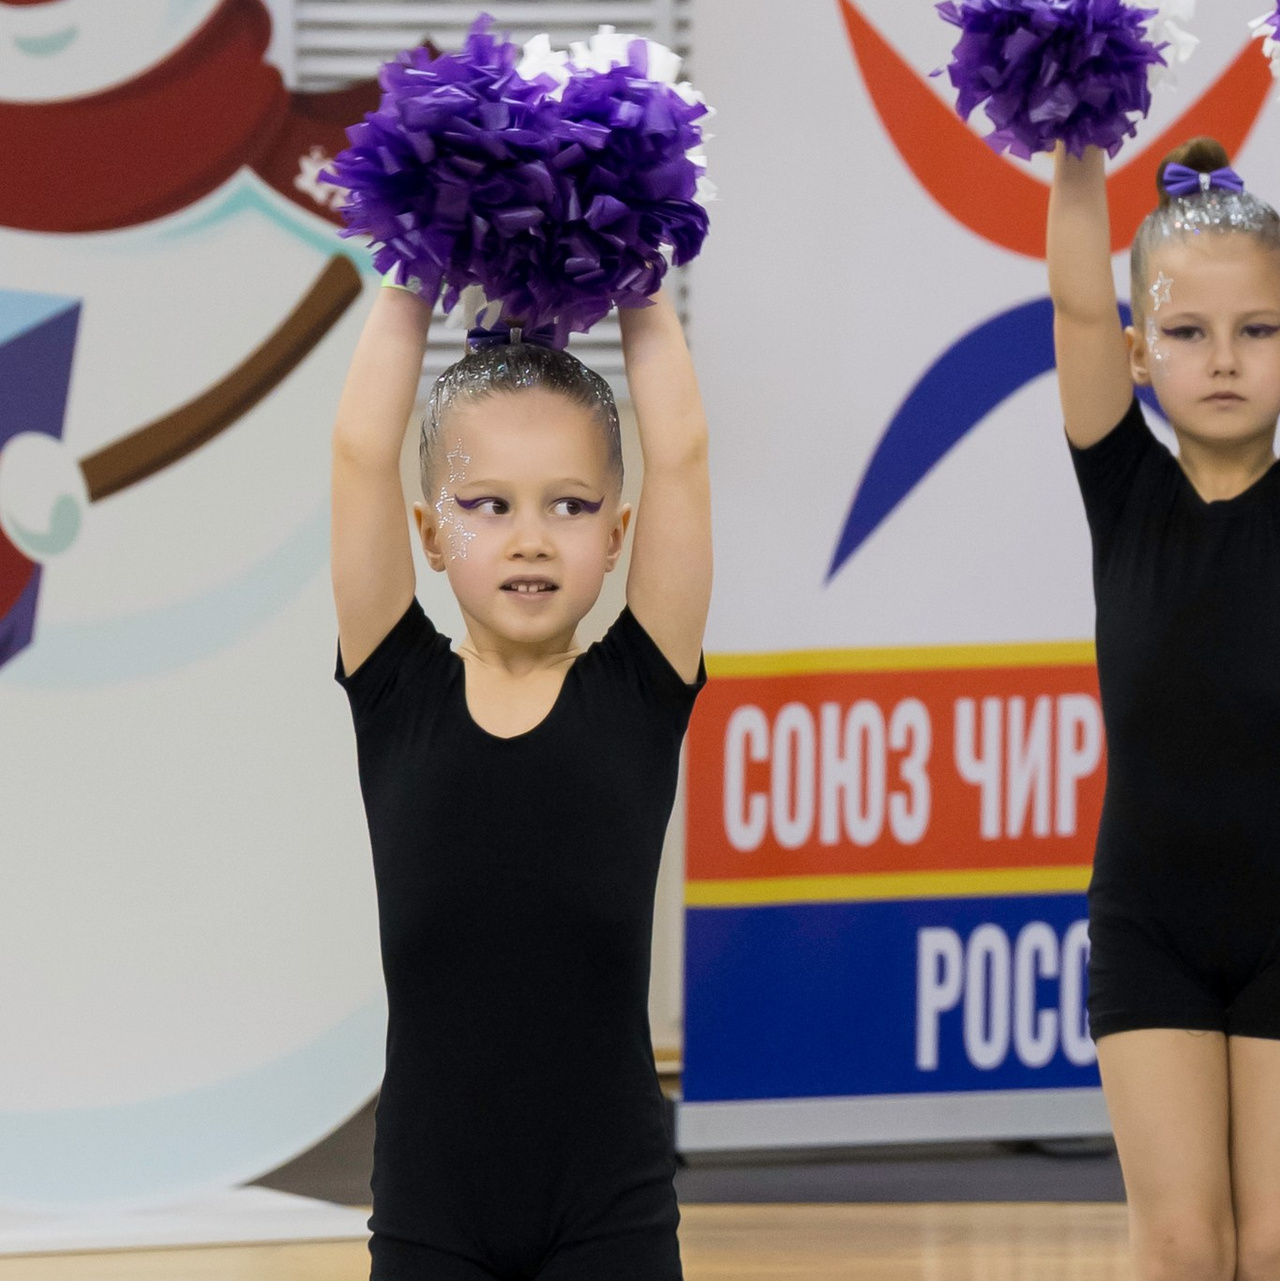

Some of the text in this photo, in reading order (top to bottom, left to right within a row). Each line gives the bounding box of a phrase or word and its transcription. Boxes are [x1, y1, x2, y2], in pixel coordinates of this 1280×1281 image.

[723, 693, 1103, 853] СОЮЗ ЧИР
[915, 920, 1097, 1071] РОСС
